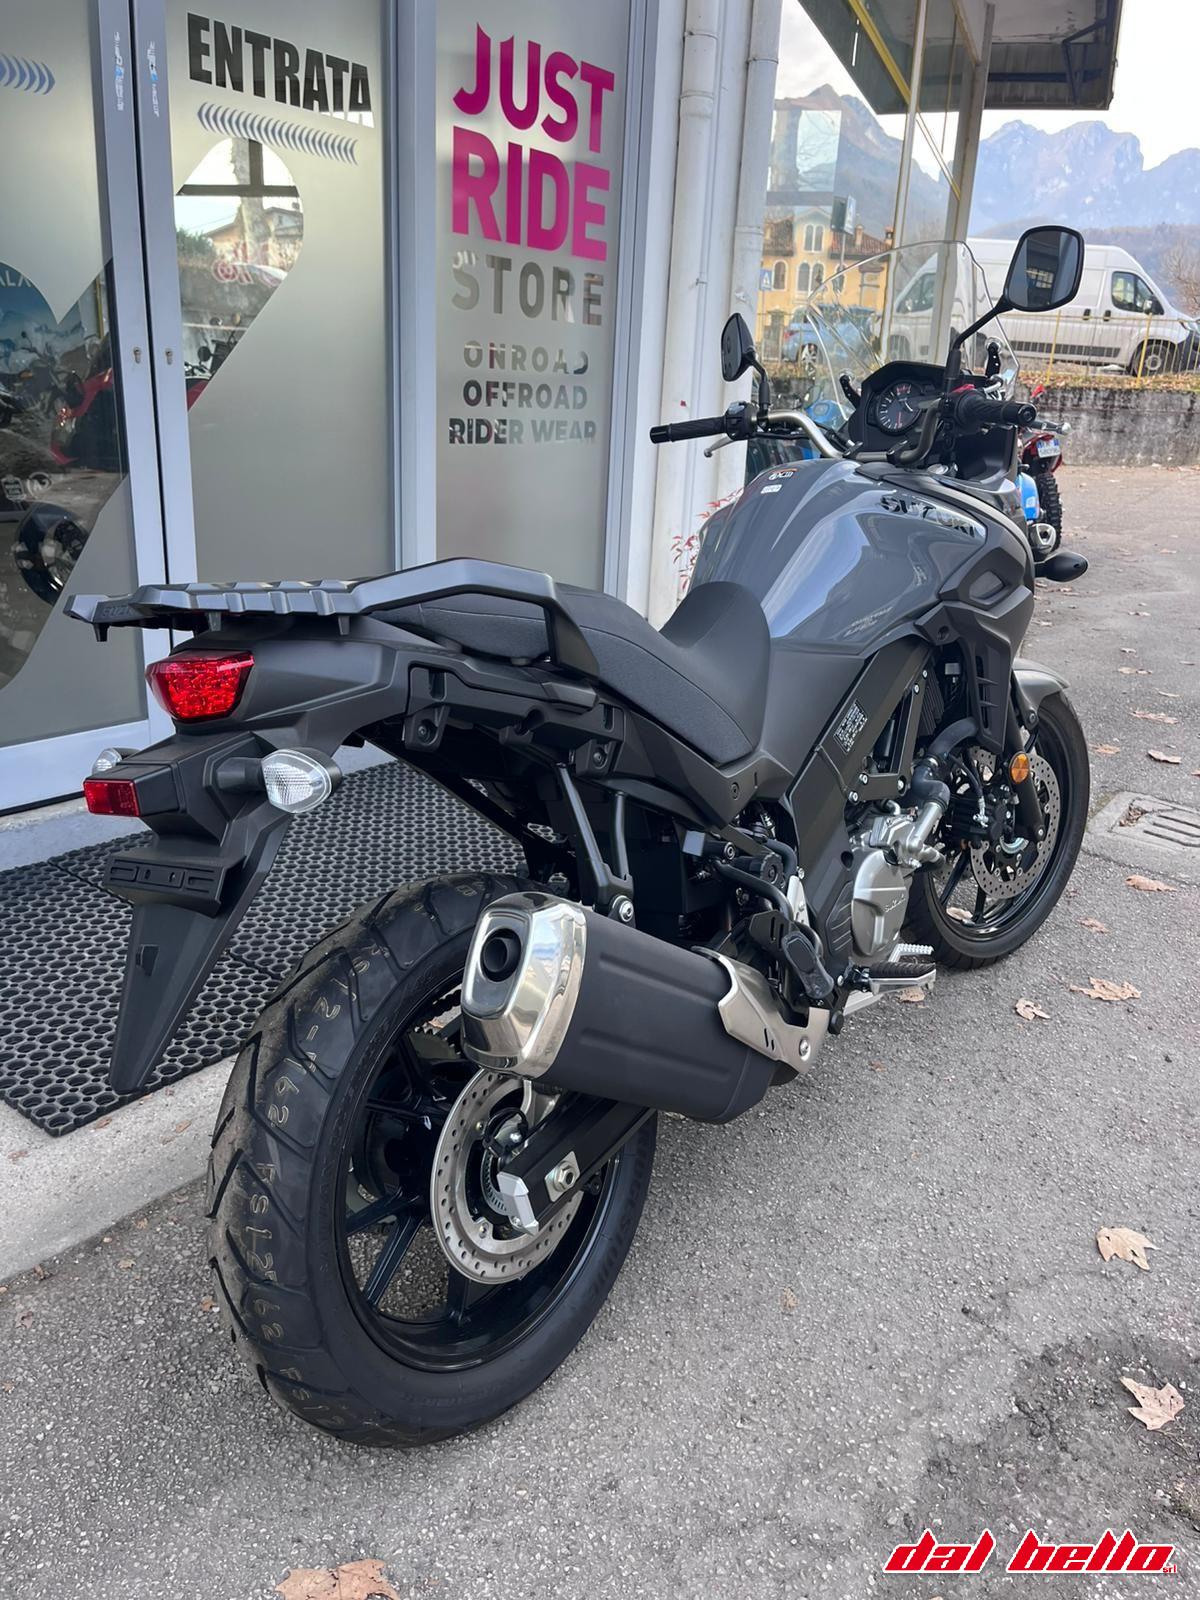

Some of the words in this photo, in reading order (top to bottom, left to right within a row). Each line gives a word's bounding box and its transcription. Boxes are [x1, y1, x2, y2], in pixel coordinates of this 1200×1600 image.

[187, 12, 374, 128] ENTRATA
[452, 22, 615, 153] JUST
[452, 125, 610, 262] RIDE
[451, 251, 604, 326] STORE
[463, 340, 589, 374] ONROAD
[463, 379, 588, 409] OFFROAD
[449, 418, 524, 444] RIDER
[530, 418, 597, 444] WEAR
